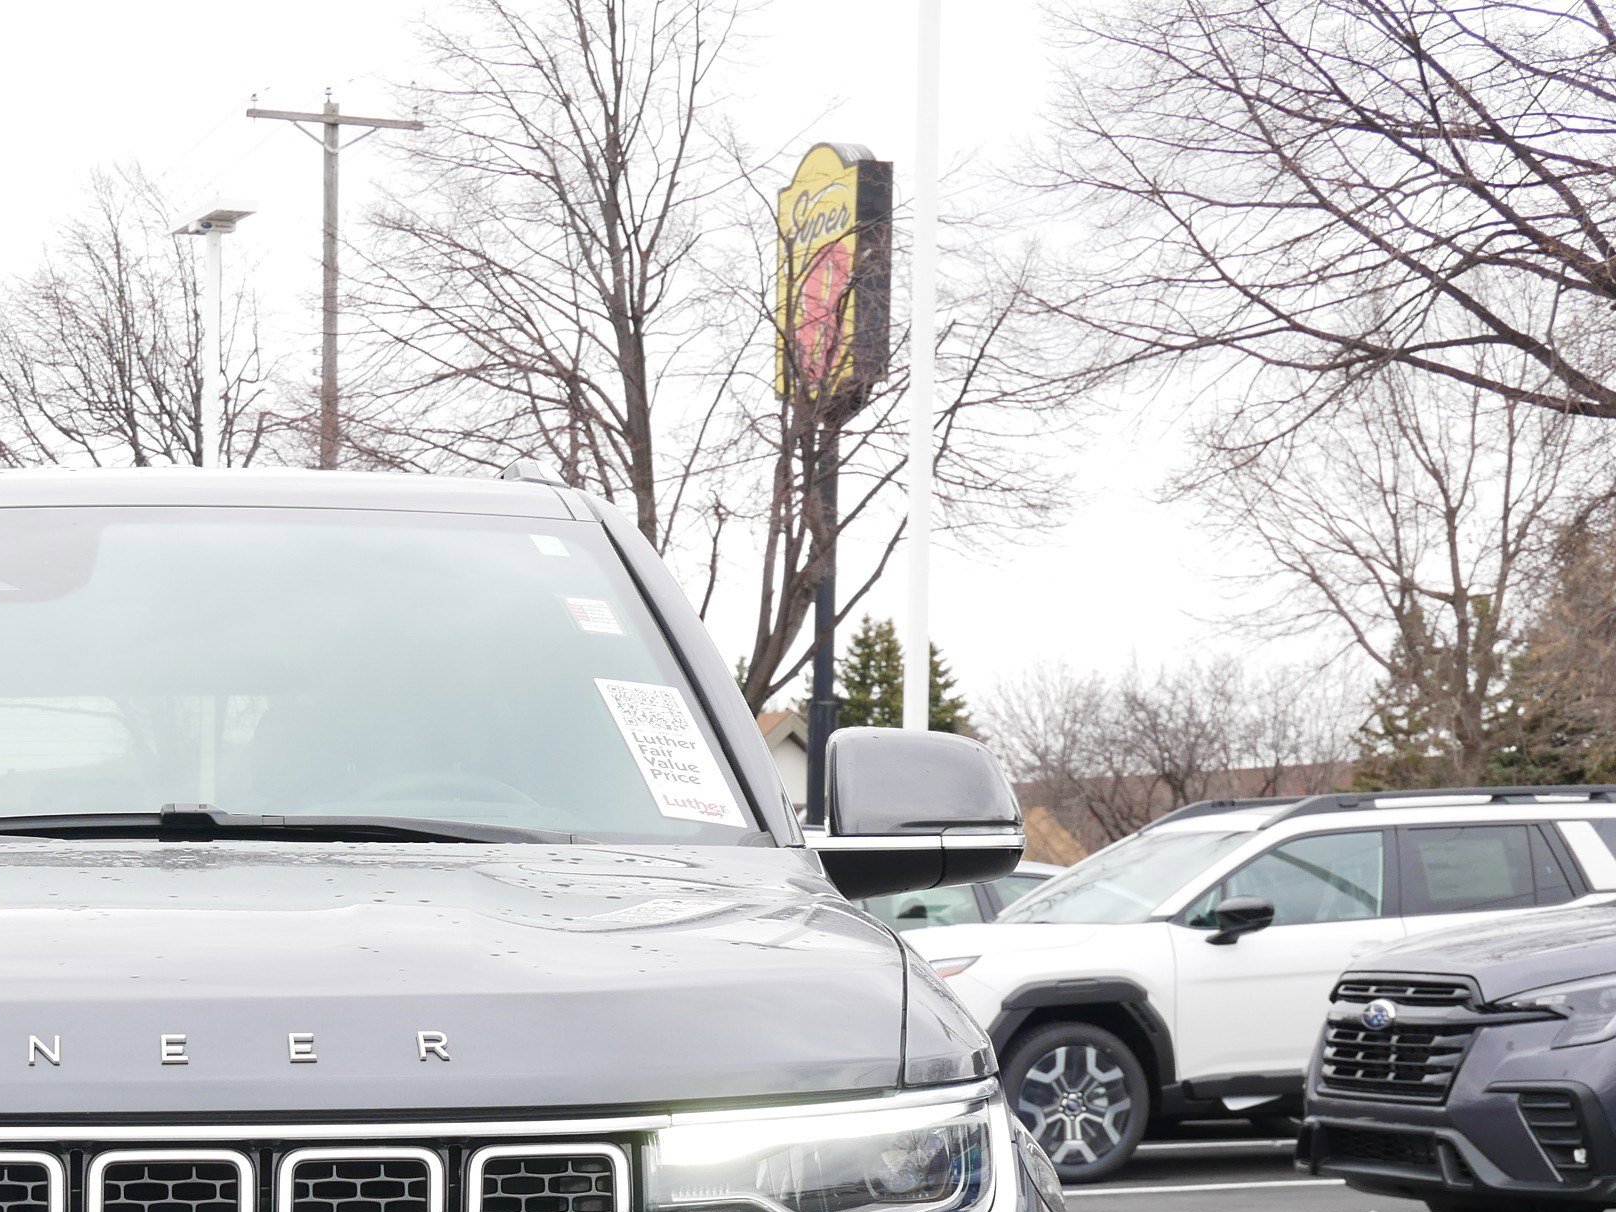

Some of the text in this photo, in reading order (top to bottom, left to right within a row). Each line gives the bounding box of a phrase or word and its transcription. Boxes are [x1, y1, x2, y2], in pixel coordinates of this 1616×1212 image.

[786, 182, 851, 270] Super
[632, 732, 695, 750] Luther
[638, 743, 672, 758] Fair
[643, 756, 700, 773] Value
[650, 768, 701, 785] Price
[663, 794, 727, 814] Luther
